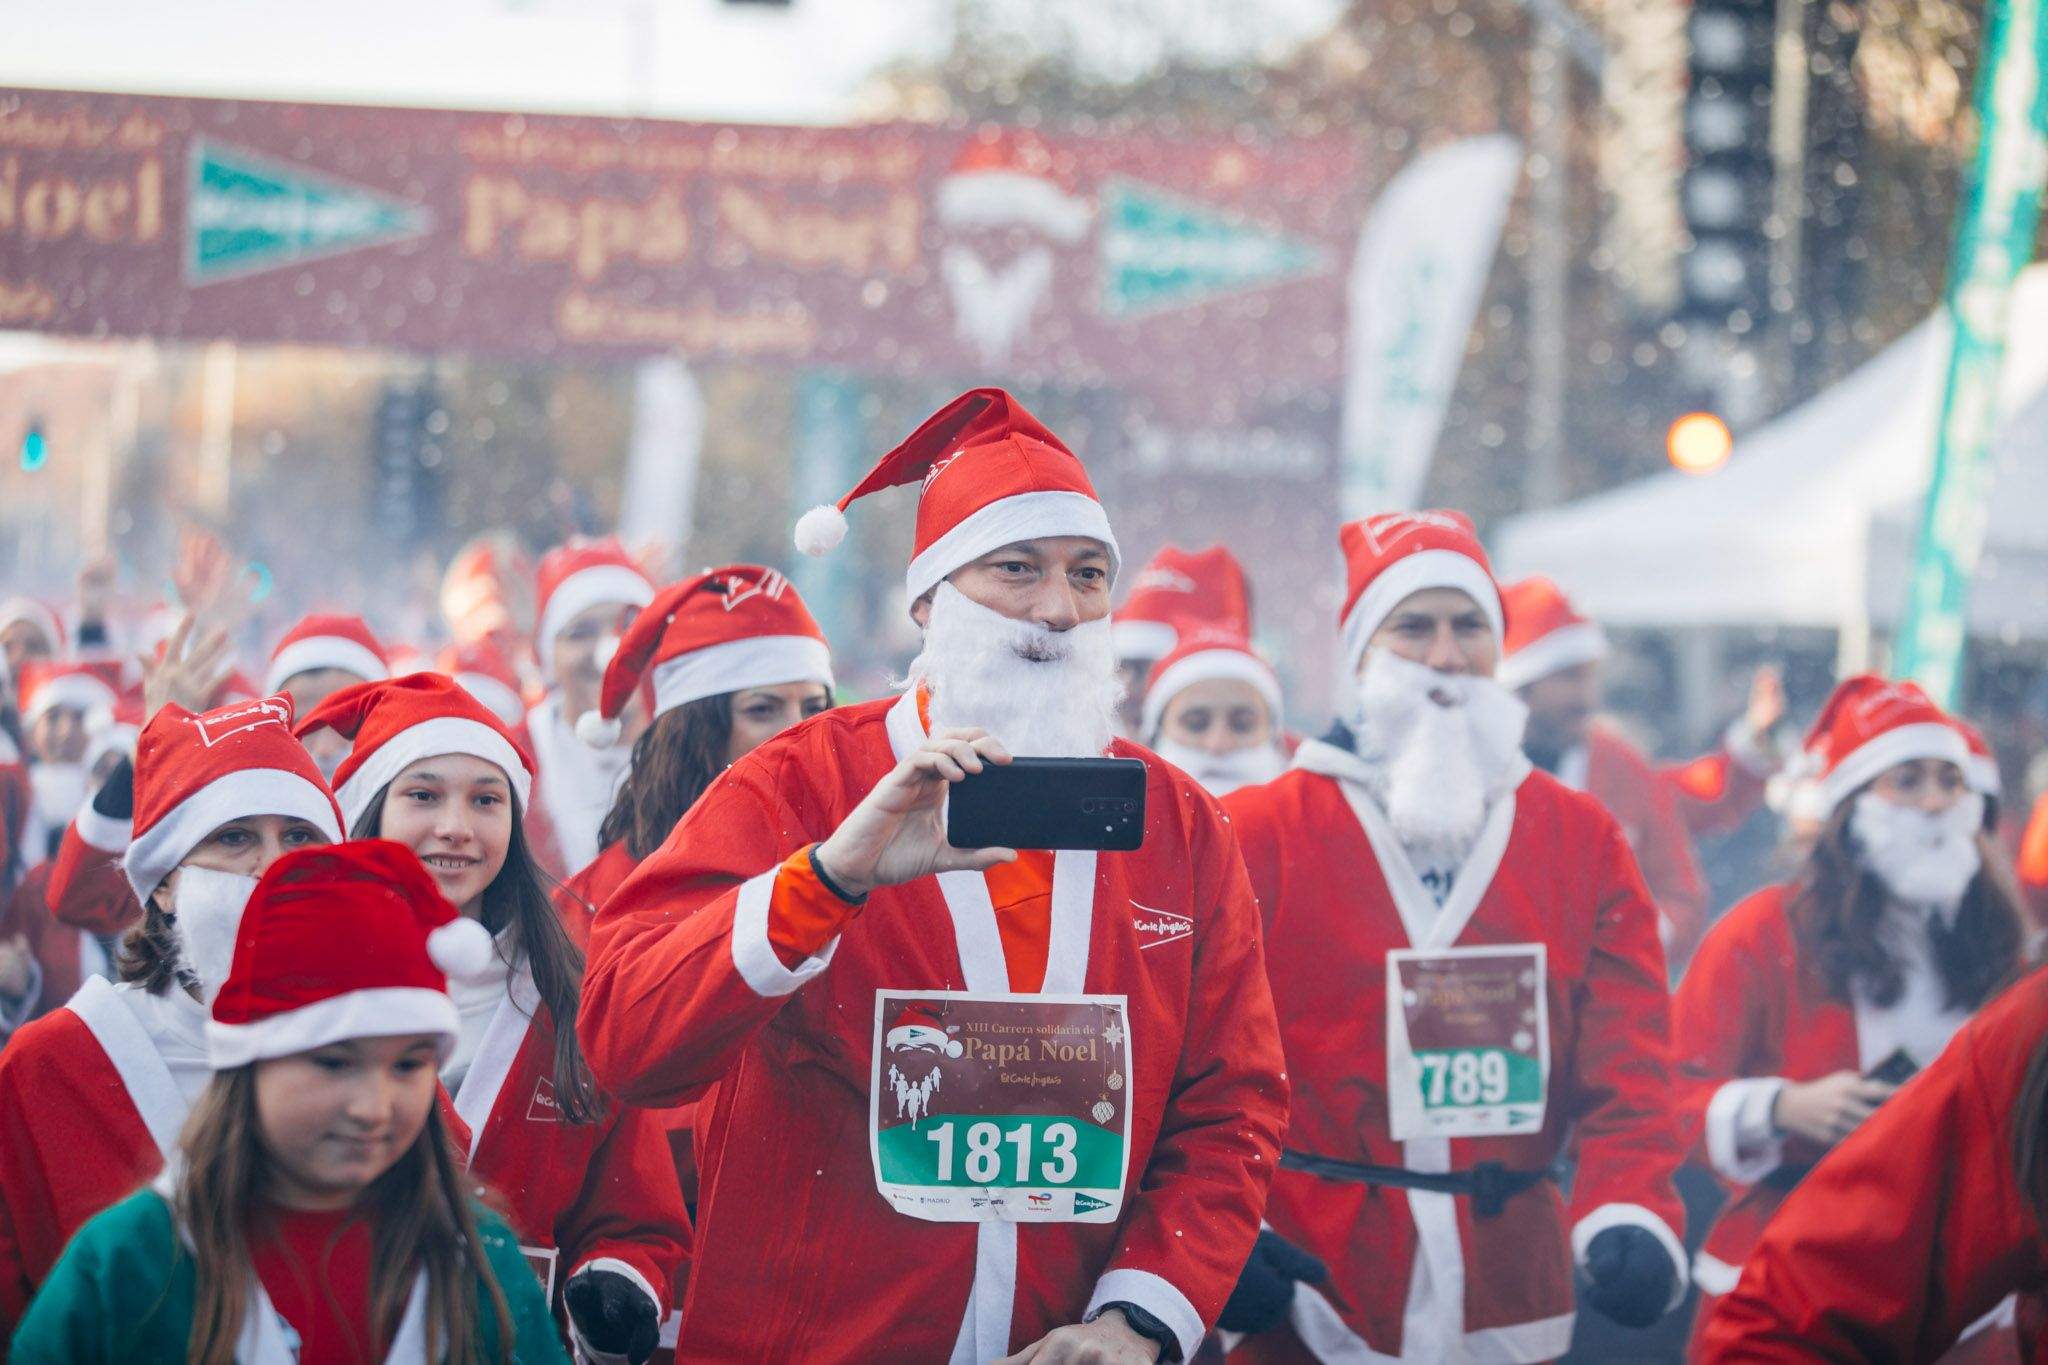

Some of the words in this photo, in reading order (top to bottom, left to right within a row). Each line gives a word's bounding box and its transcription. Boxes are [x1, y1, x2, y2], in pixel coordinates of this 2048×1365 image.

[966, 1022, 989, 1033] XIII
[991, 1024, 1033, 1034] Carrera
[1036, 1024, 1080, 1036] solidaria
[1083, 1025, 1096, 1035] de
[964, 1037, 1031, 1068] Papá
[1040, 1038, 1097, 1062] Noel
[927, 1122, 1078, 1183] 1813
